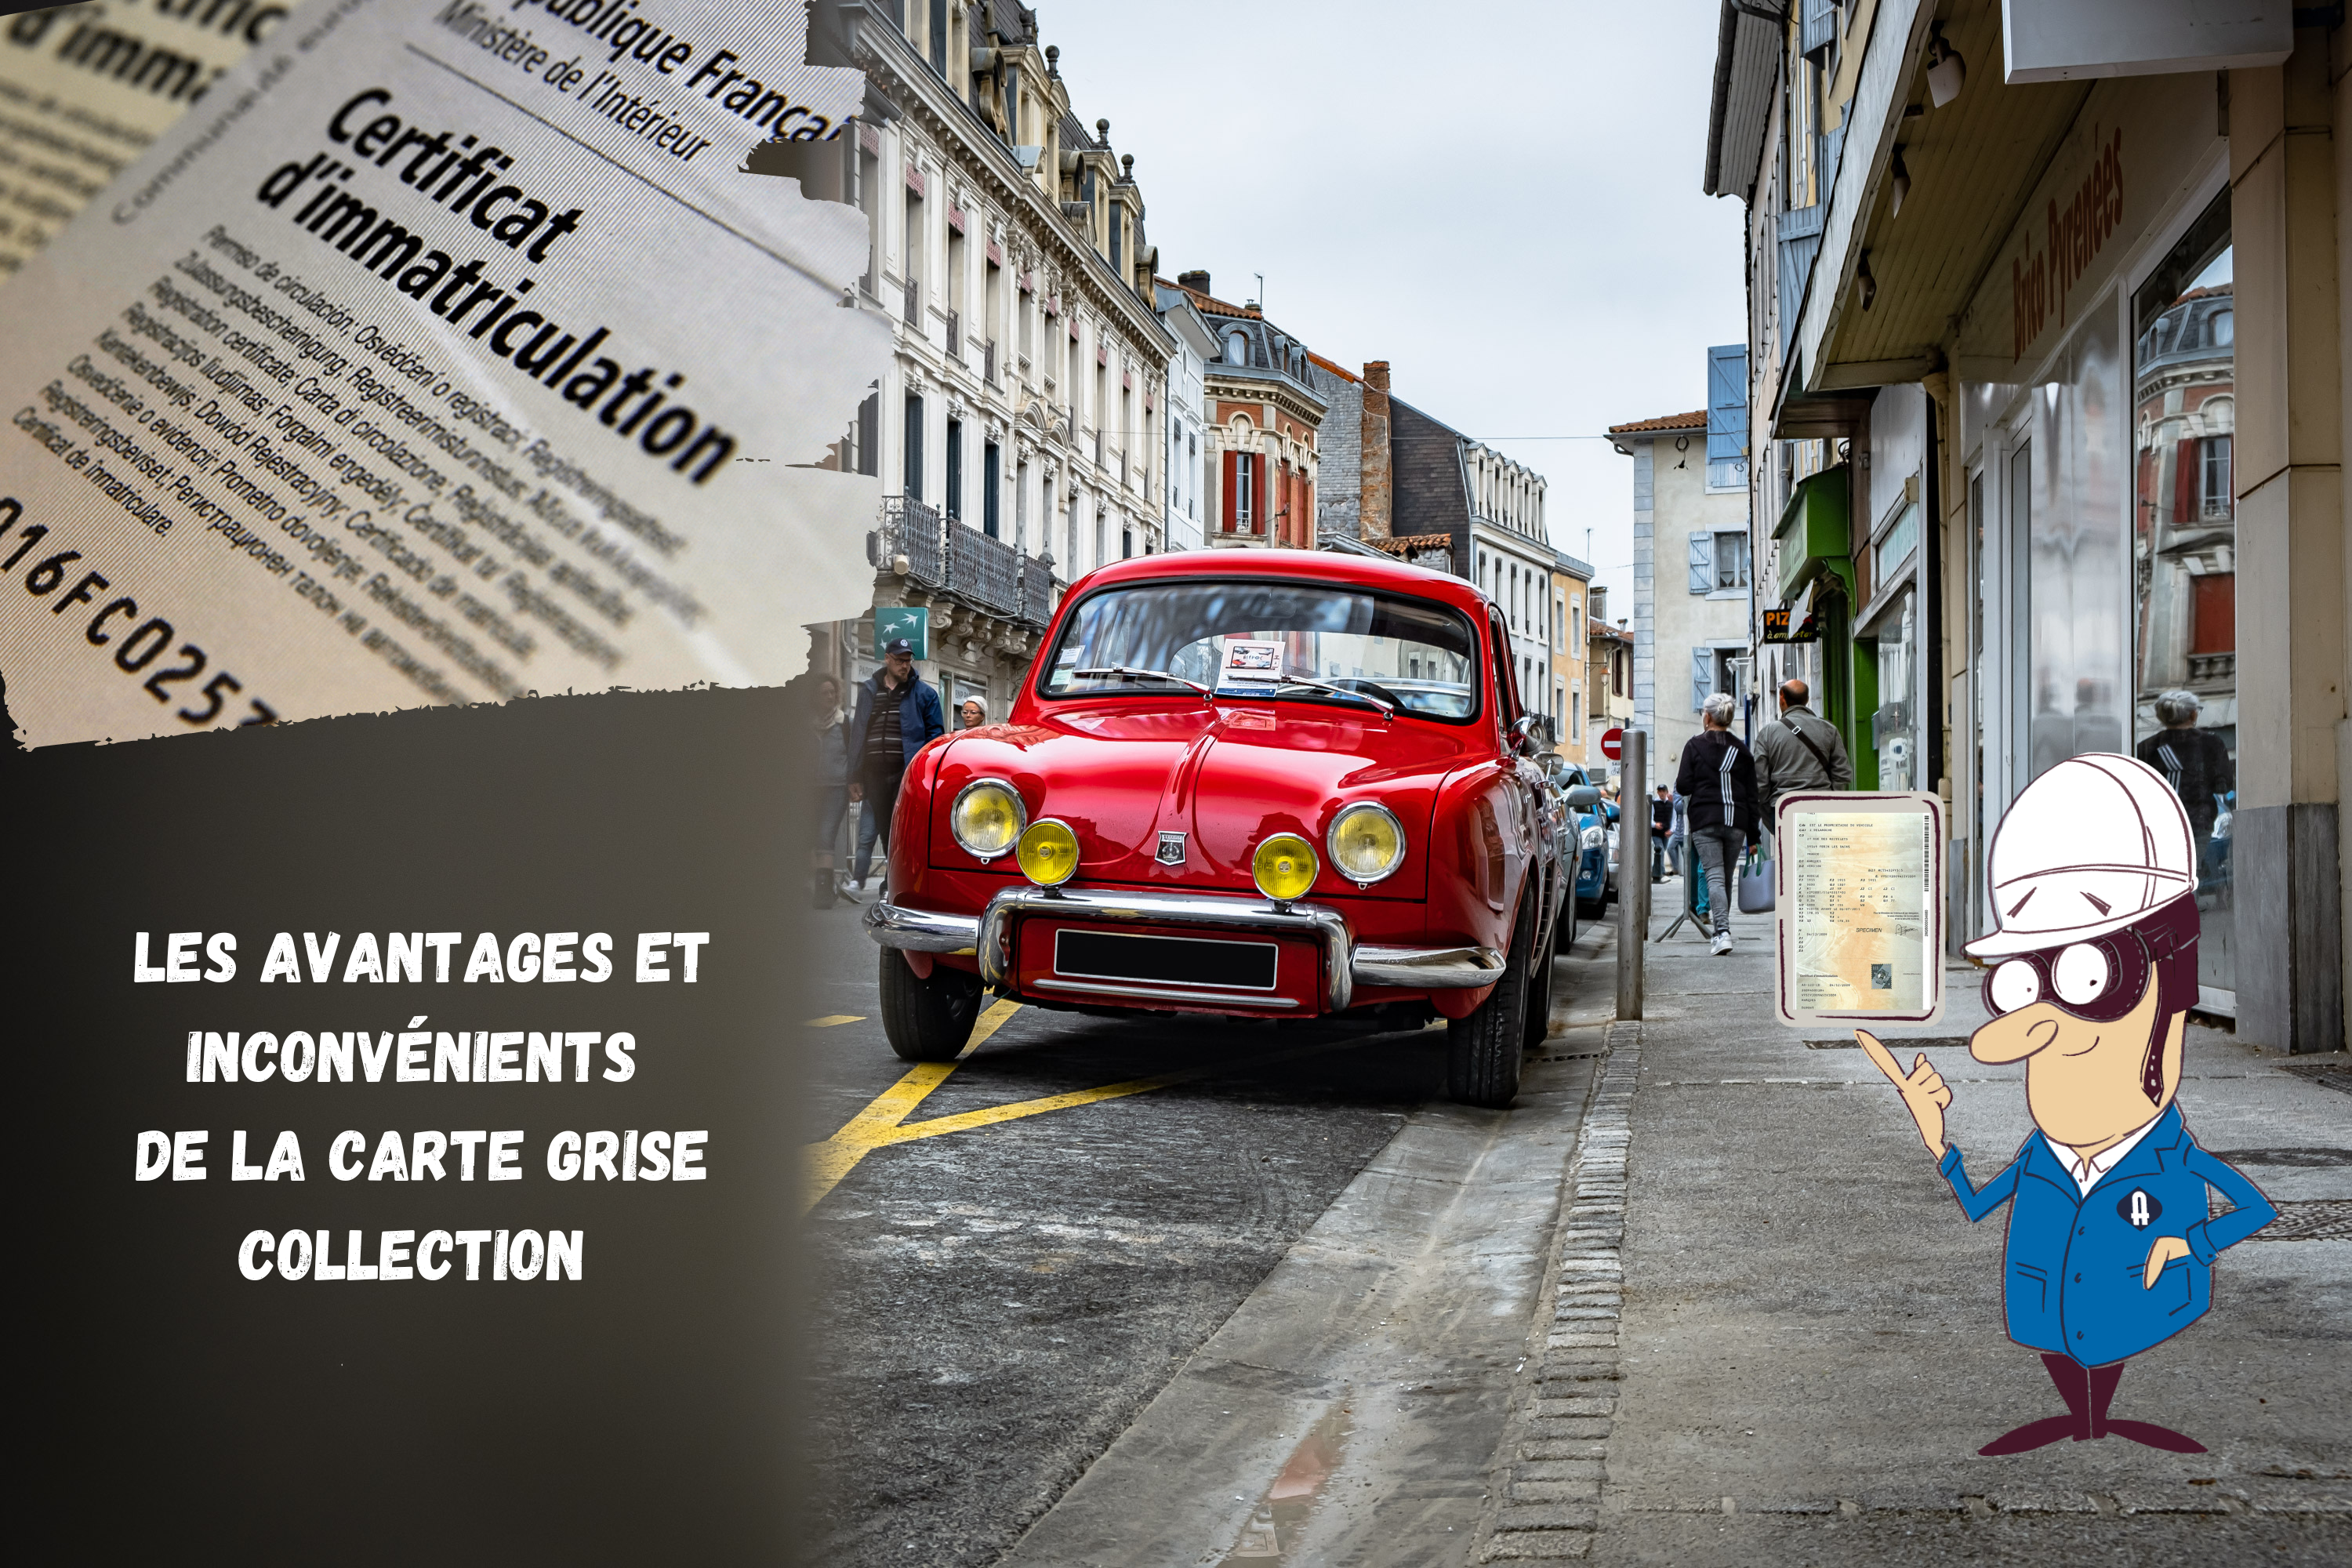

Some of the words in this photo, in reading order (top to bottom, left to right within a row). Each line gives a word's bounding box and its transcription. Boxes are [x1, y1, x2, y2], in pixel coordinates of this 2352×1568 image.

[511, 0, 692, 74] ublique
[543, 56, 583, 93] de
[576, 69, 713, 163] l'Intérieur
[328, 87, 584, 265] Certificat
[2013, 229, 2046, 366] Brico
[2047, 122, 2125, 330] Pyrenées
[254, 262, 280, 282] de
[273, 275, 355, 337] circulación;
[354, 325, 445, 387] Osvědčení
[431, 382, 452, 397] o
[256, 151, 741, 488] d'immatriculation
[137, 409, 156, 424] o
[148, 418, 220, 474] evidencii;
[210, 459, 287, 522] Prometno
[194, 399, 256, 447] Dowód
[222, 331, 300, 388] certificate;
[293, 376, 341, 416] Carta
[333, 408, 360, 426] di
[350, 420, 448, 496] circolazione;
[266, 403, 336, 459] Forgalmi
[64, 449, 89, 470] de
[82, 459, 173, 535] înmatriculare.
[1766, 612, 1789, 626] PIZ
